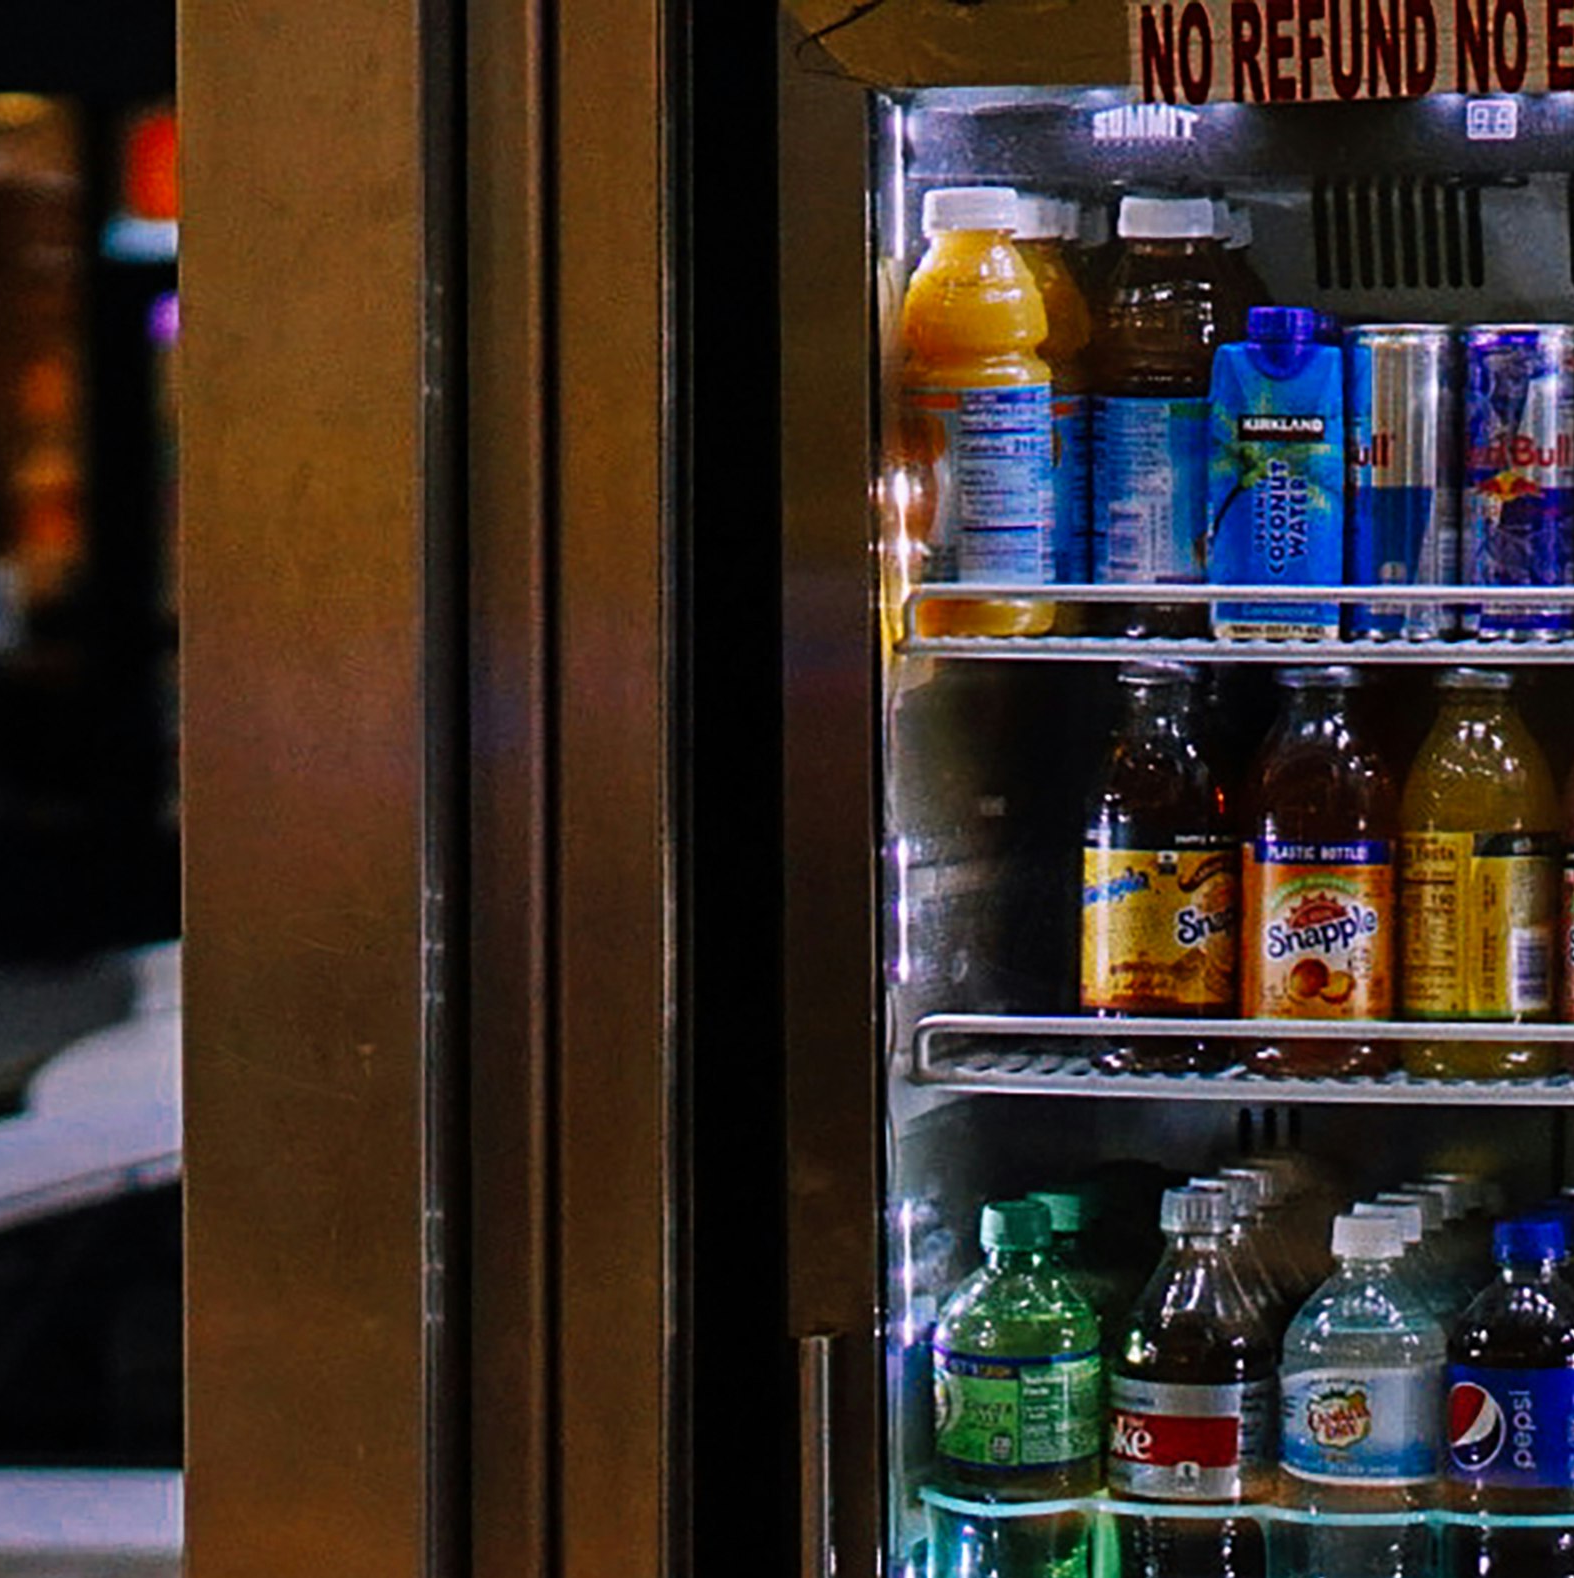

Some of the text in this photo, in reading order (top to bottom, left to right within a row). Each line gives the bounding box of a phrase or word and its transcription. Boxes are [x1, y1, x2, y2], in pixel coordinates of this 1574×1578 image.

[1140, 2, 1213, 105] NO
[1232, 0, 1438, 102] REFUND
[1455, 0, 1527, 95] NO
[1092, 102, 1199, 140] SUMMIT
[1242, 417, 1324, 434] KIRKLAND
[1511, 434, 1574, 467] Bull
[1268, 459, 1288, 574] COCONUT
[1289, 474, 1309, 559] WATER
[1267, 845, 1316, 862] PLASTIC
[1267, 904, 1378, 959] Snapple
[1508, 1389, 1538, 1472] pepsi
